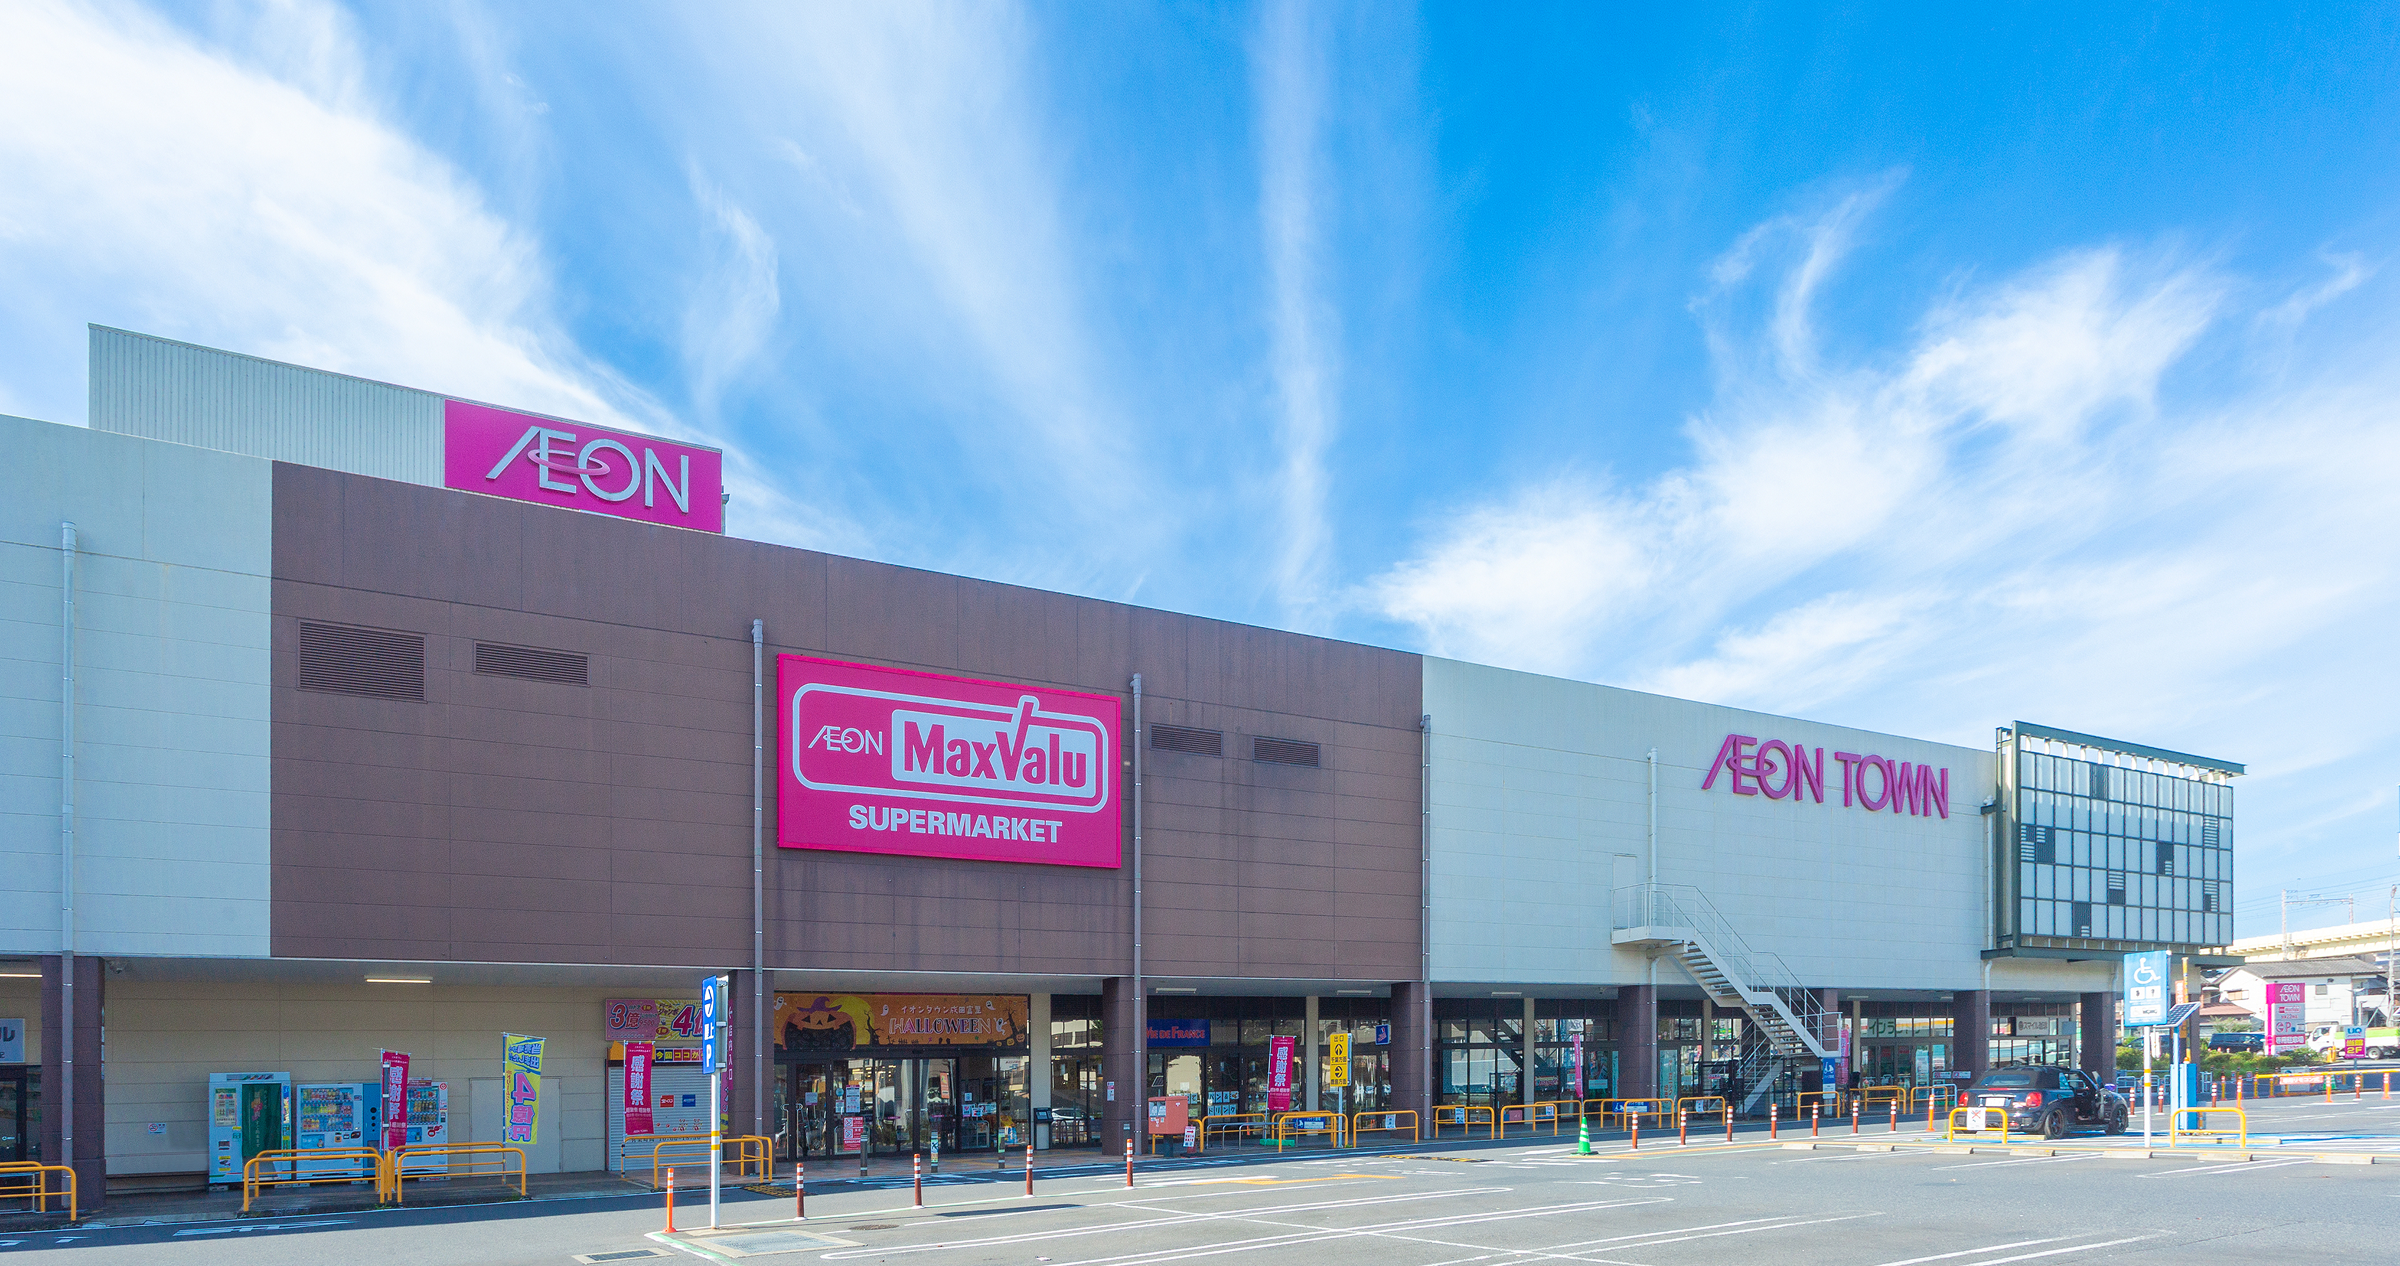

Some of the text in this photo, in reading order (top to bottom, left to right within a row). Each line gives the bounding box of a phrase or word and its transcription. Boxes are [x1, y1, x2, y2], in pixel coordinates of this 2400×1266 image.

[903, 702, 1087, 788] MaxValu
[1834, 751, 1949, 819] TOWN
[849, 804, 1063, 843] SUPERMARKET
[889, 1017, 992, 1034] HALLOWEEN
[901, 1005, 982, 1015] イオンタウン成田富里
[630, 1055, 645, 1106] 感謝祭
[1274, 1046, 1289, 1087] 感謝祭
